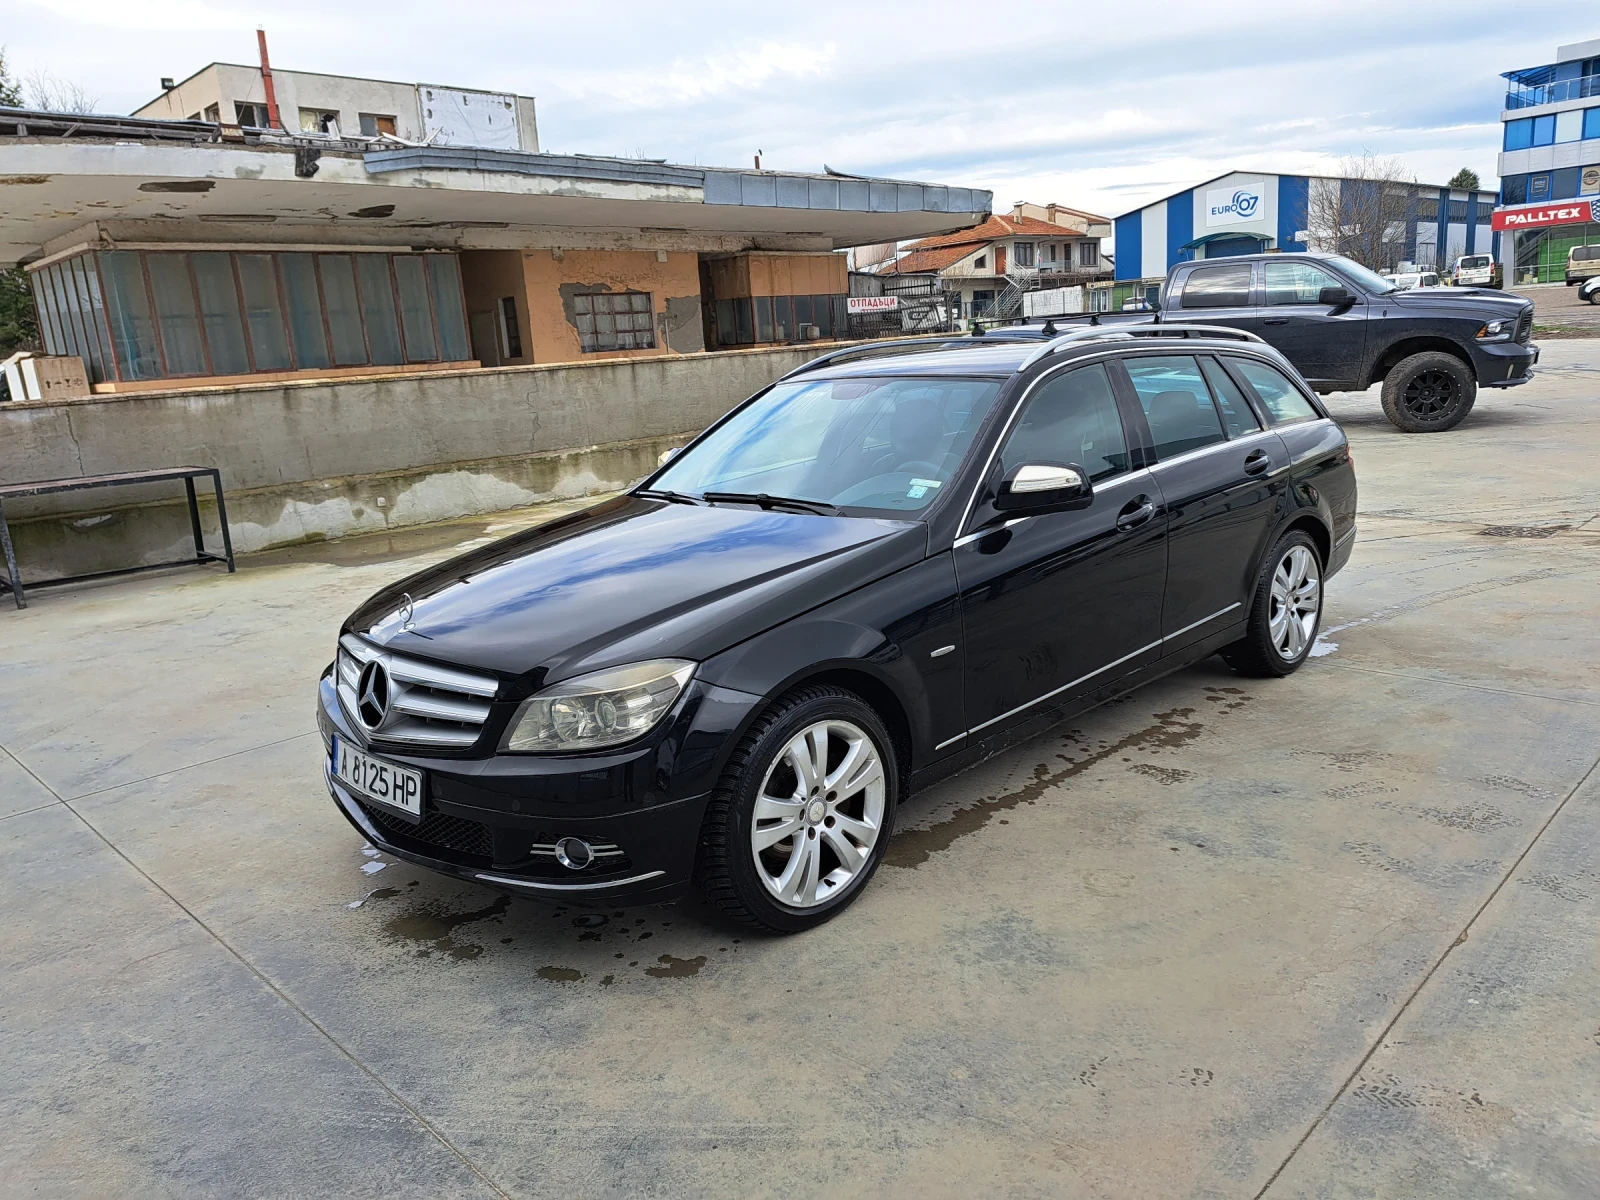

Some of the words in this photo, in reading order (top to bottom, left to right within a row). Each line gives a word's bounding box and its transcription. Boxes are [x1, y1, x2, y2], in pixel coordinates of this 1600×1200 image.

[1211, 203, 1238, 216] EURO
[1504, 207, 1582, 226] PALLTEX
[850, 297, 896, 308] ОТПАДЪЦИ
[341, 747, 348, 778] A
[352, 755, 389, 797] 8125
[393, 770, 417, 806] HP
